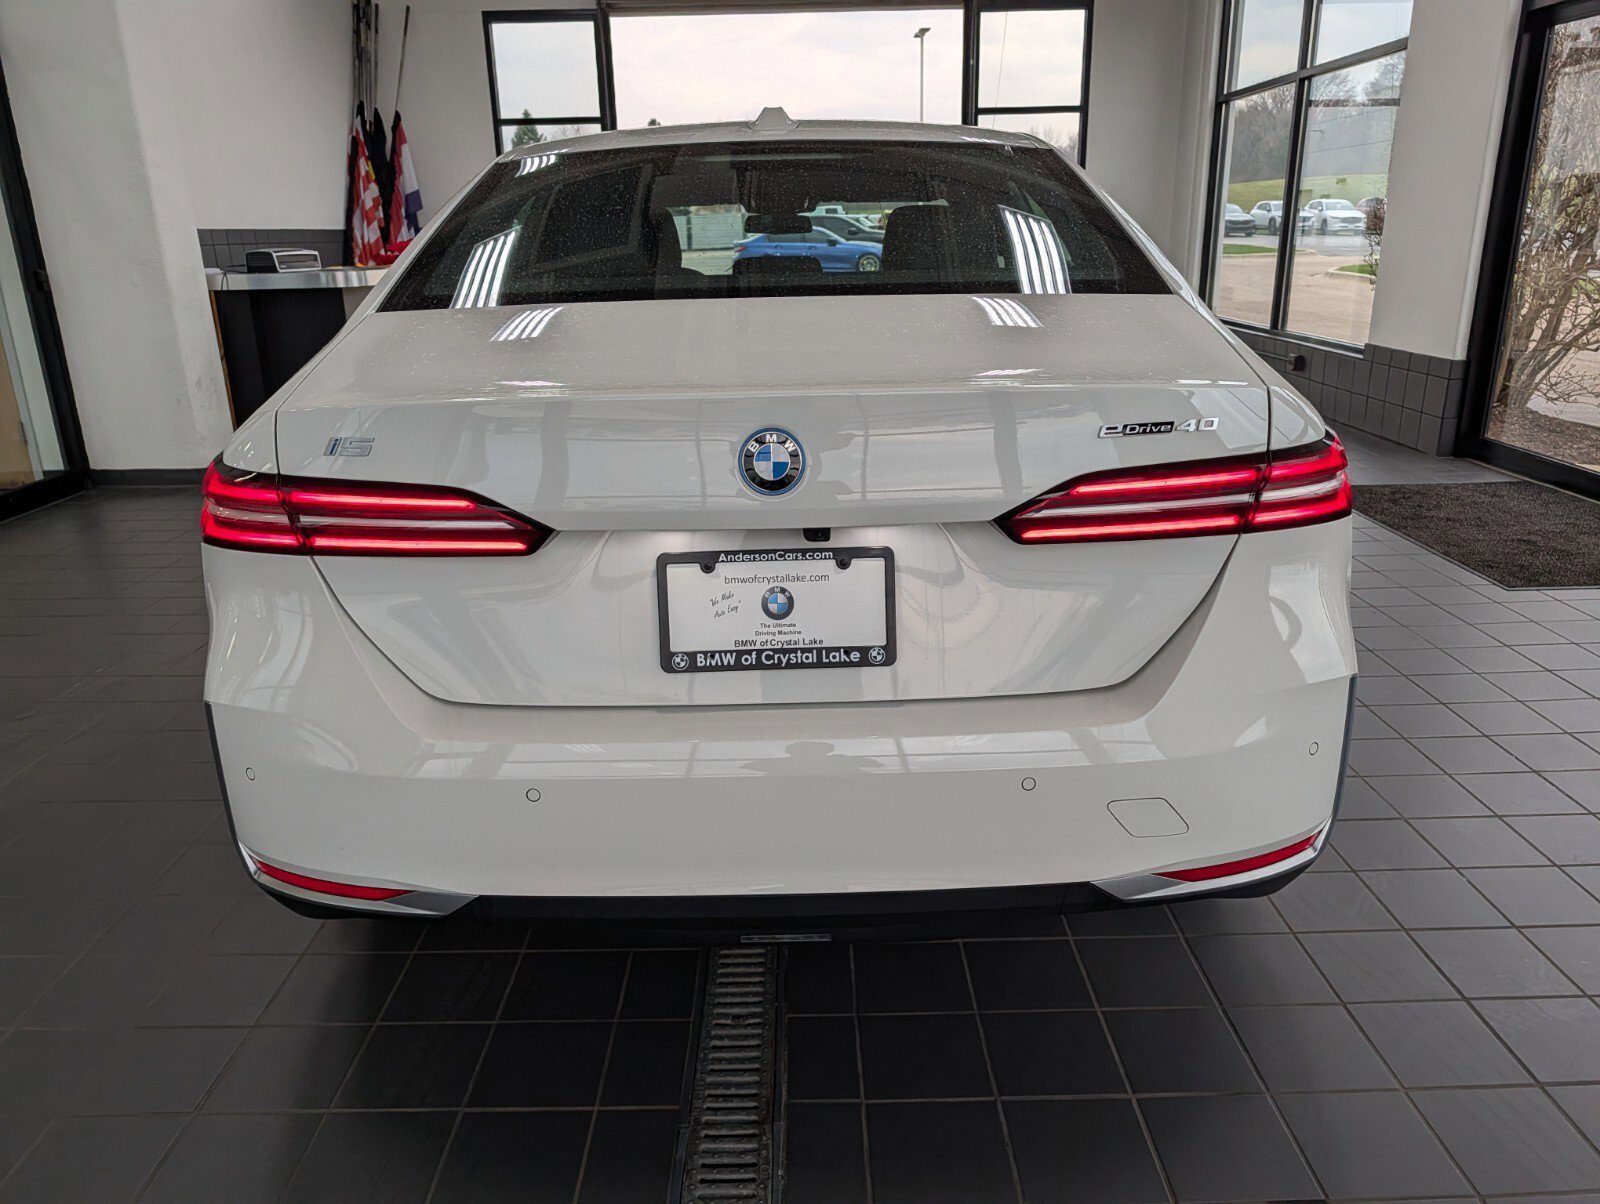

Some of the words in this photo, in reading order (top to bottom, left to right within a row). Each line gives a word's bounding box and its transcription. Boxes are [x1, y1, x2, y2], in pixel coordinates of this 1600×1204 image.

[1175, 417, 1220, 432] 40
[748, 433, 796, 452] BMW
[718, 550, 834, 562] AndersonCars.com
[724, 573, 830, 585] bmwofcrystallake.com
[734, 639, 757, 648] BMW
[759, 639, 769, 647] of
[769, 637, 800, 648] Crystal
[802, 637, 824, 646] Lake
[696, 652, 736, 667] BMW
[741, 650, 757, 665] of
[761, 649, 817, 667] Crystal
[822, 648, 861, 663] Lake
